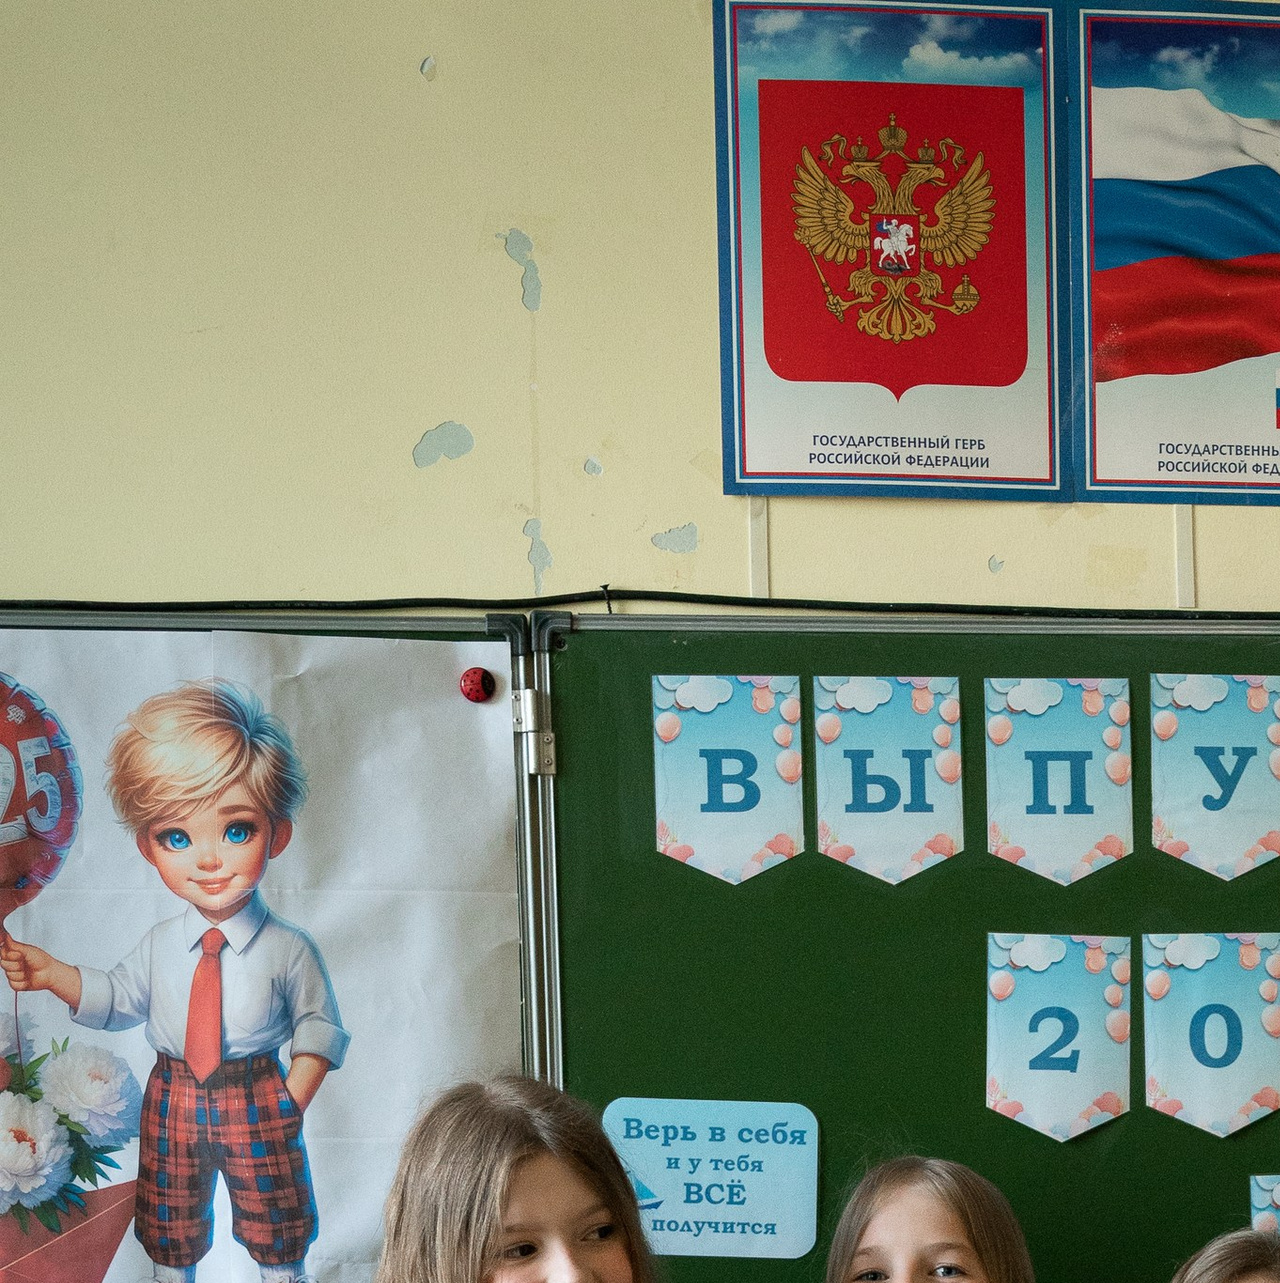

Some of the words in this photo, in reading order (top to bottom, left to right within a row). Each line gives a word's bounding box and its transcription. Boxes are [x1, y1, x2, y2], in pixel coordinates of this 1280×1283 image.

[813, 434, 950, 449] ГОСУДАРСТВЕННЫЙ
[955, 438, 986, 450] ГЕРБ
[809, 451, 901, 466] РОССИЙСКОЙ
[905, 454, 989, 469] ФЕДЕРАЦИИ
[1158, 459, 1247, 474] РОССИЙСКОЙ
[623, 1117, 697, 1147] Верь
[708, 1126, 726, 1142] в
[738, 1121, 807, 1146] себя
[666, 1156, 680, 1170] и
[688, 1158, 702, 1174] у
[709, 1154, 763, 1172] тебя
[683, 1179, 747, 1206] ВСЁ
[652, 1218, 777, 1237] получится
